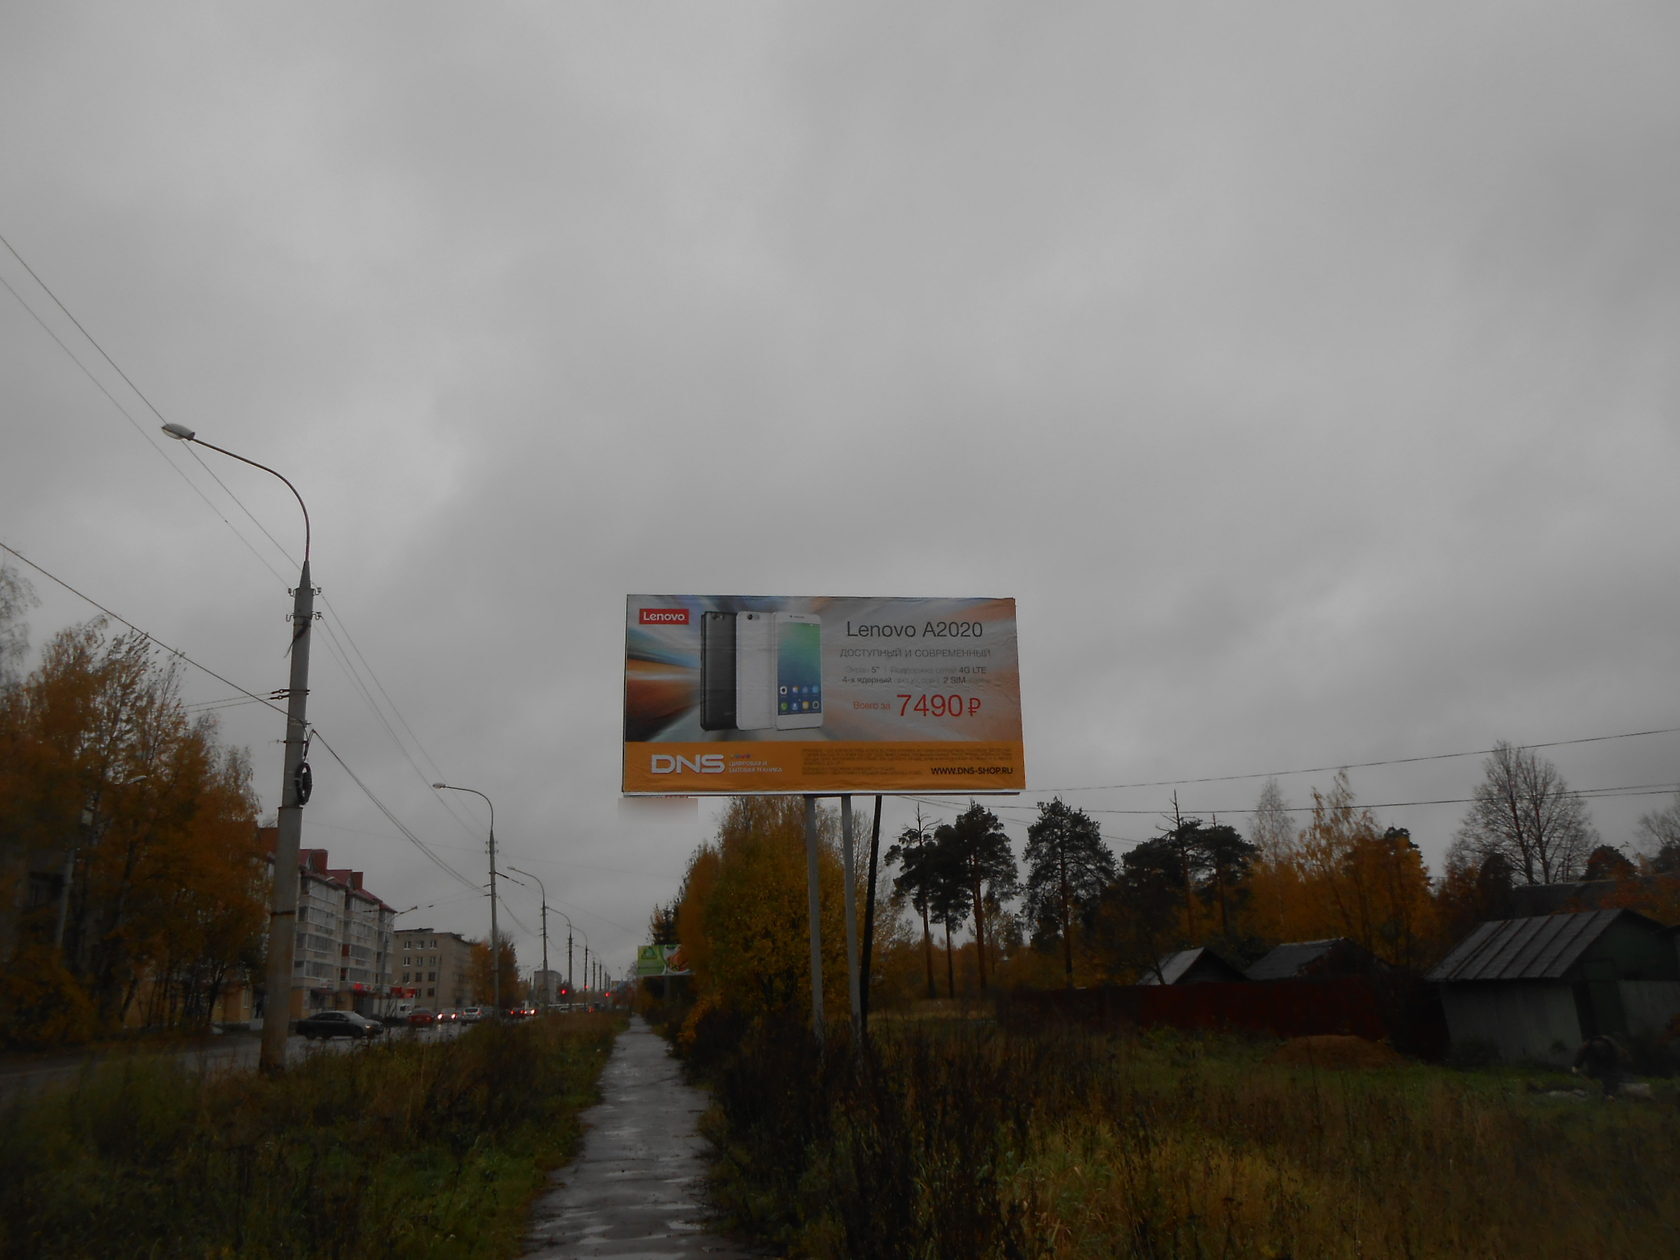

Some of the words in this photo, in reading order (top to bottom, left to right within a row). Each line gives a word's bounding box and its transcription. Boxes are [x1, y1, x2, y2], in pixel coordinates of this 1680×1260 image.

[643, 611, 686, 621] Lenovo
[846, 621, 916, 638] Lenovo
[922, 621, 983, 638] A2020
[840, 647, 903, 658] ДОСТУПНЫЙ
[904, 648, 912, 657] И
[914, 647, 992, 658] СОВРЕМЕННЫЙ
[958, 666, 970, 674] 4G
[972, 666, 987, 674] LTE
[950, 676, 966, 684] SIM
[896, 694, 963, 717] 7490
[651, 754, 725, 774] DNS
[931, 766, 1014, 775] WWW.DNS-SHOP.RU
